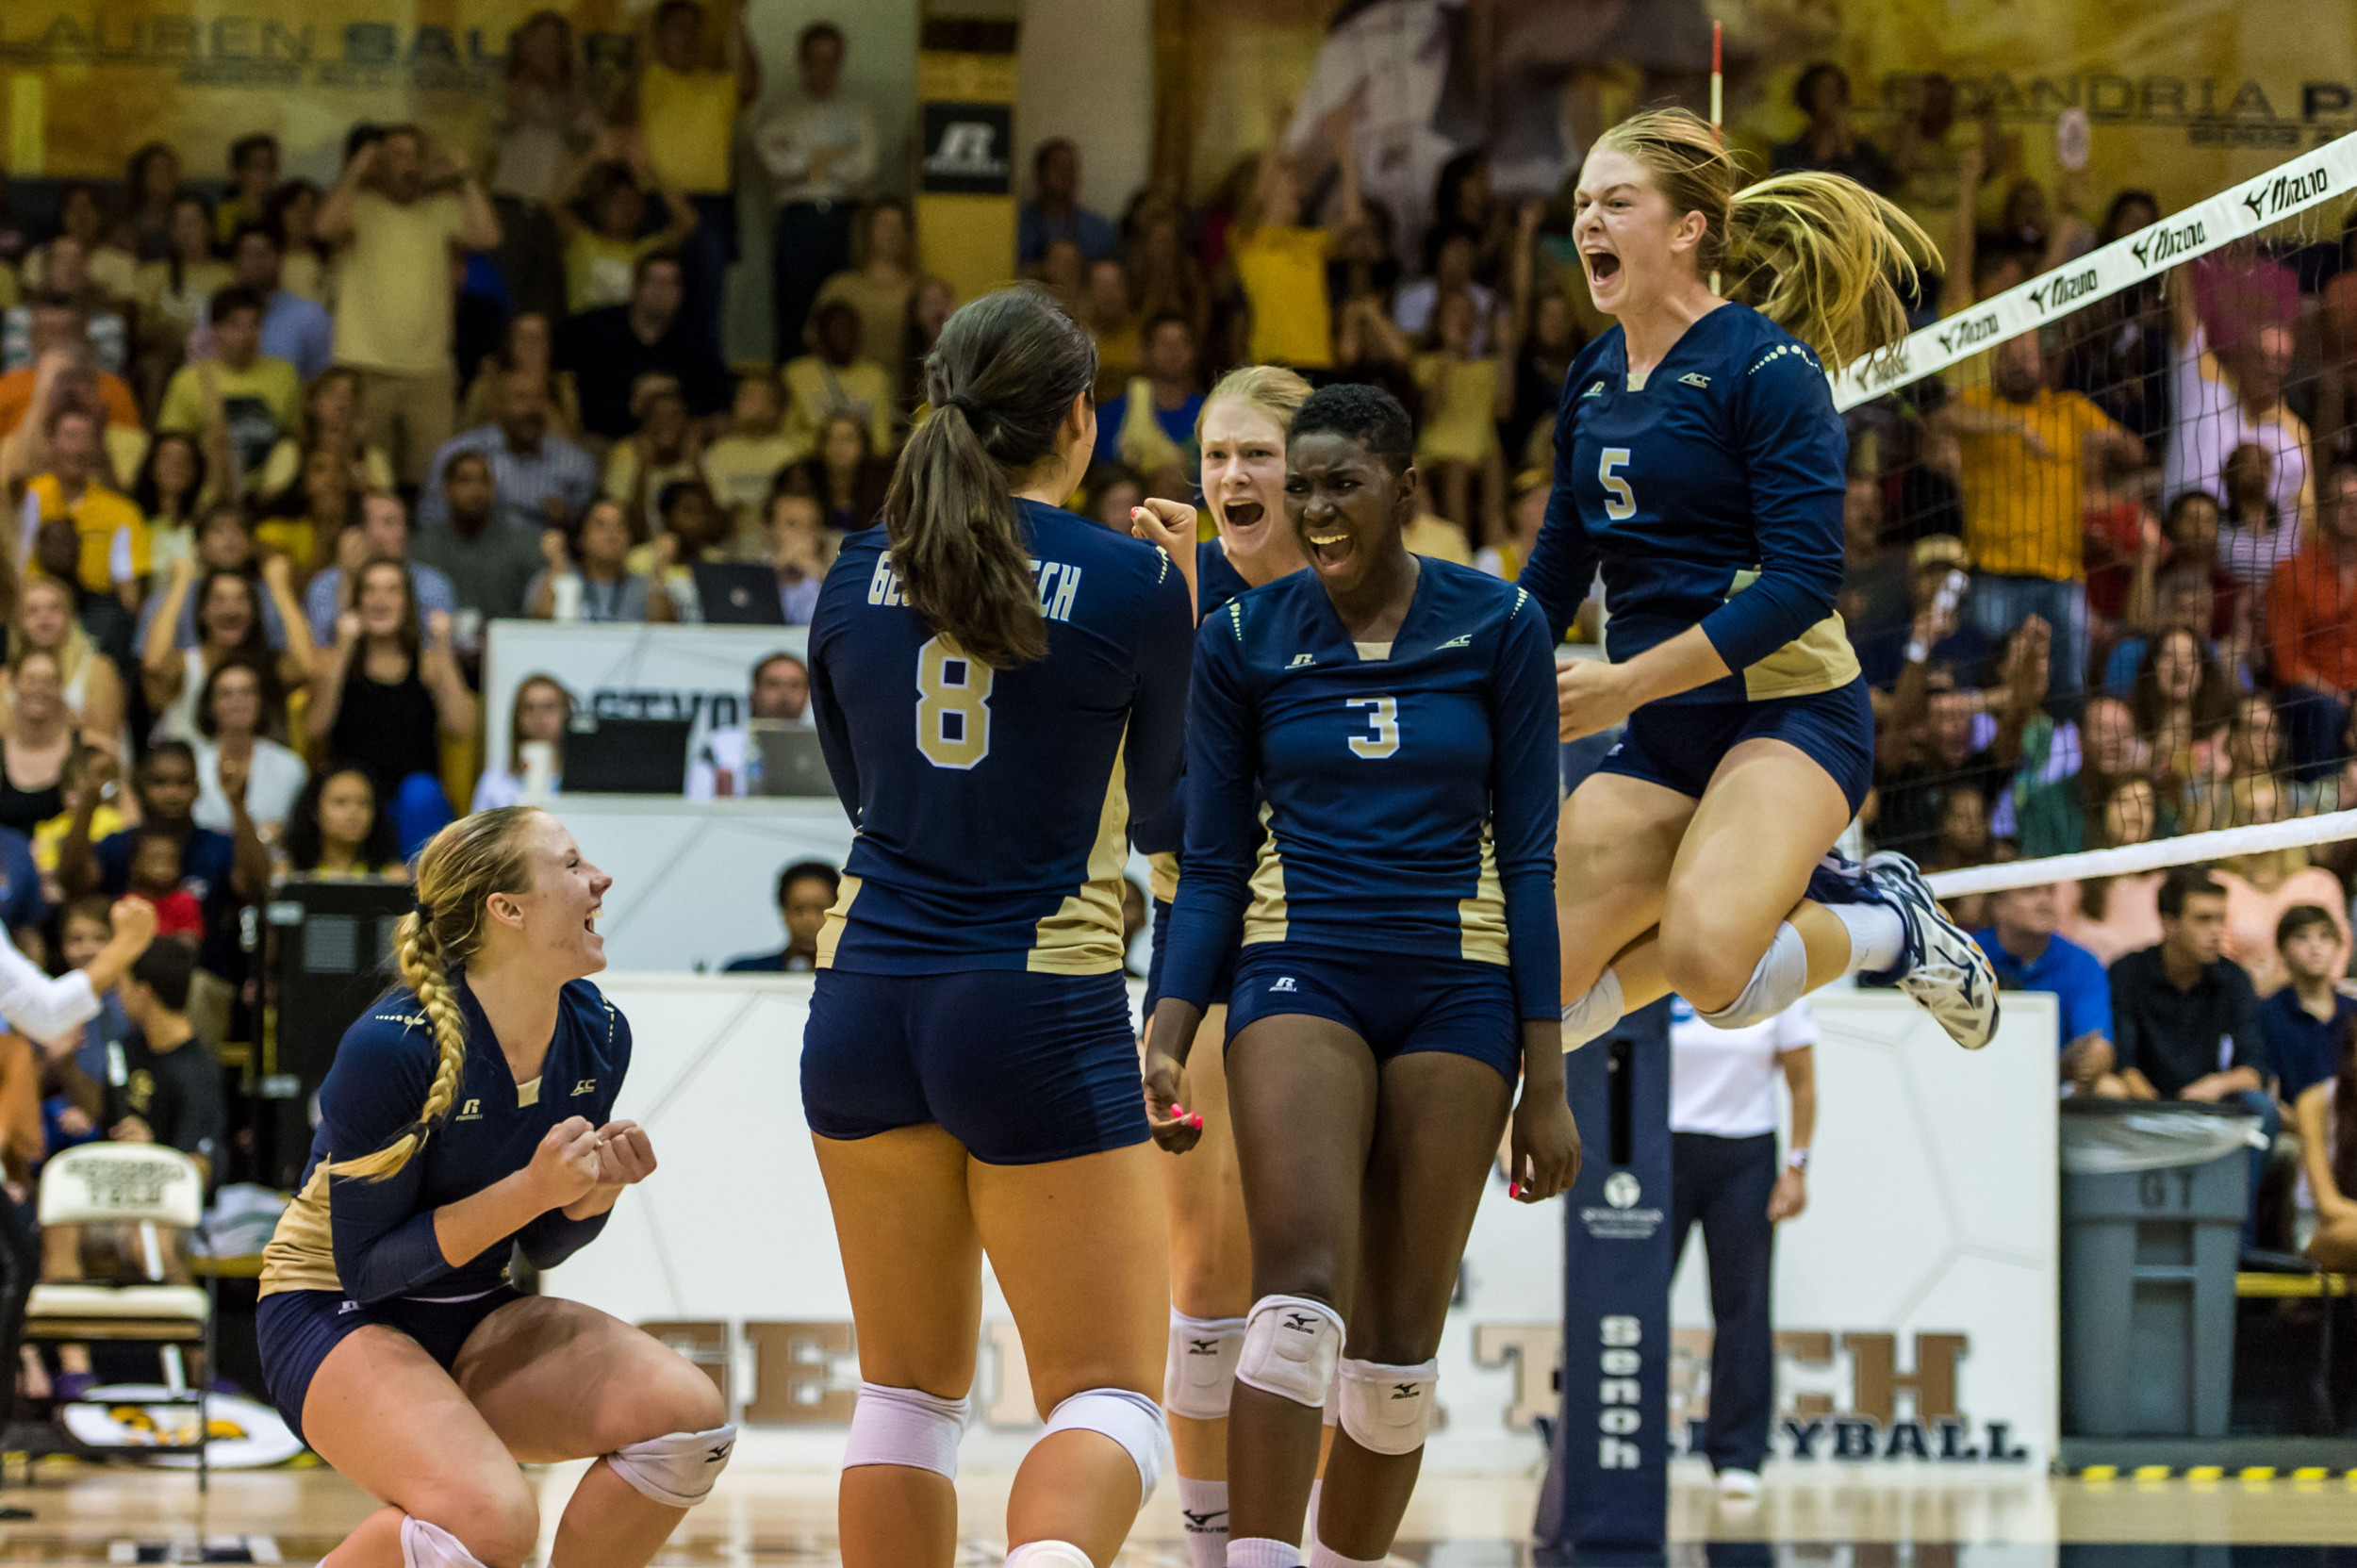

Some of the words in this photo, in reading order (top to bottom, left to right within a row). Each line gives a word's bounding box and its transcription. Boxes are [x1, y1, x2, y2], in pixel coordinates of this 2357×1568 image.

[1598, 447, 1638, 520] 5
[915, 631, 994, 770] 8
[1345, 696, 1401, 760] 3
